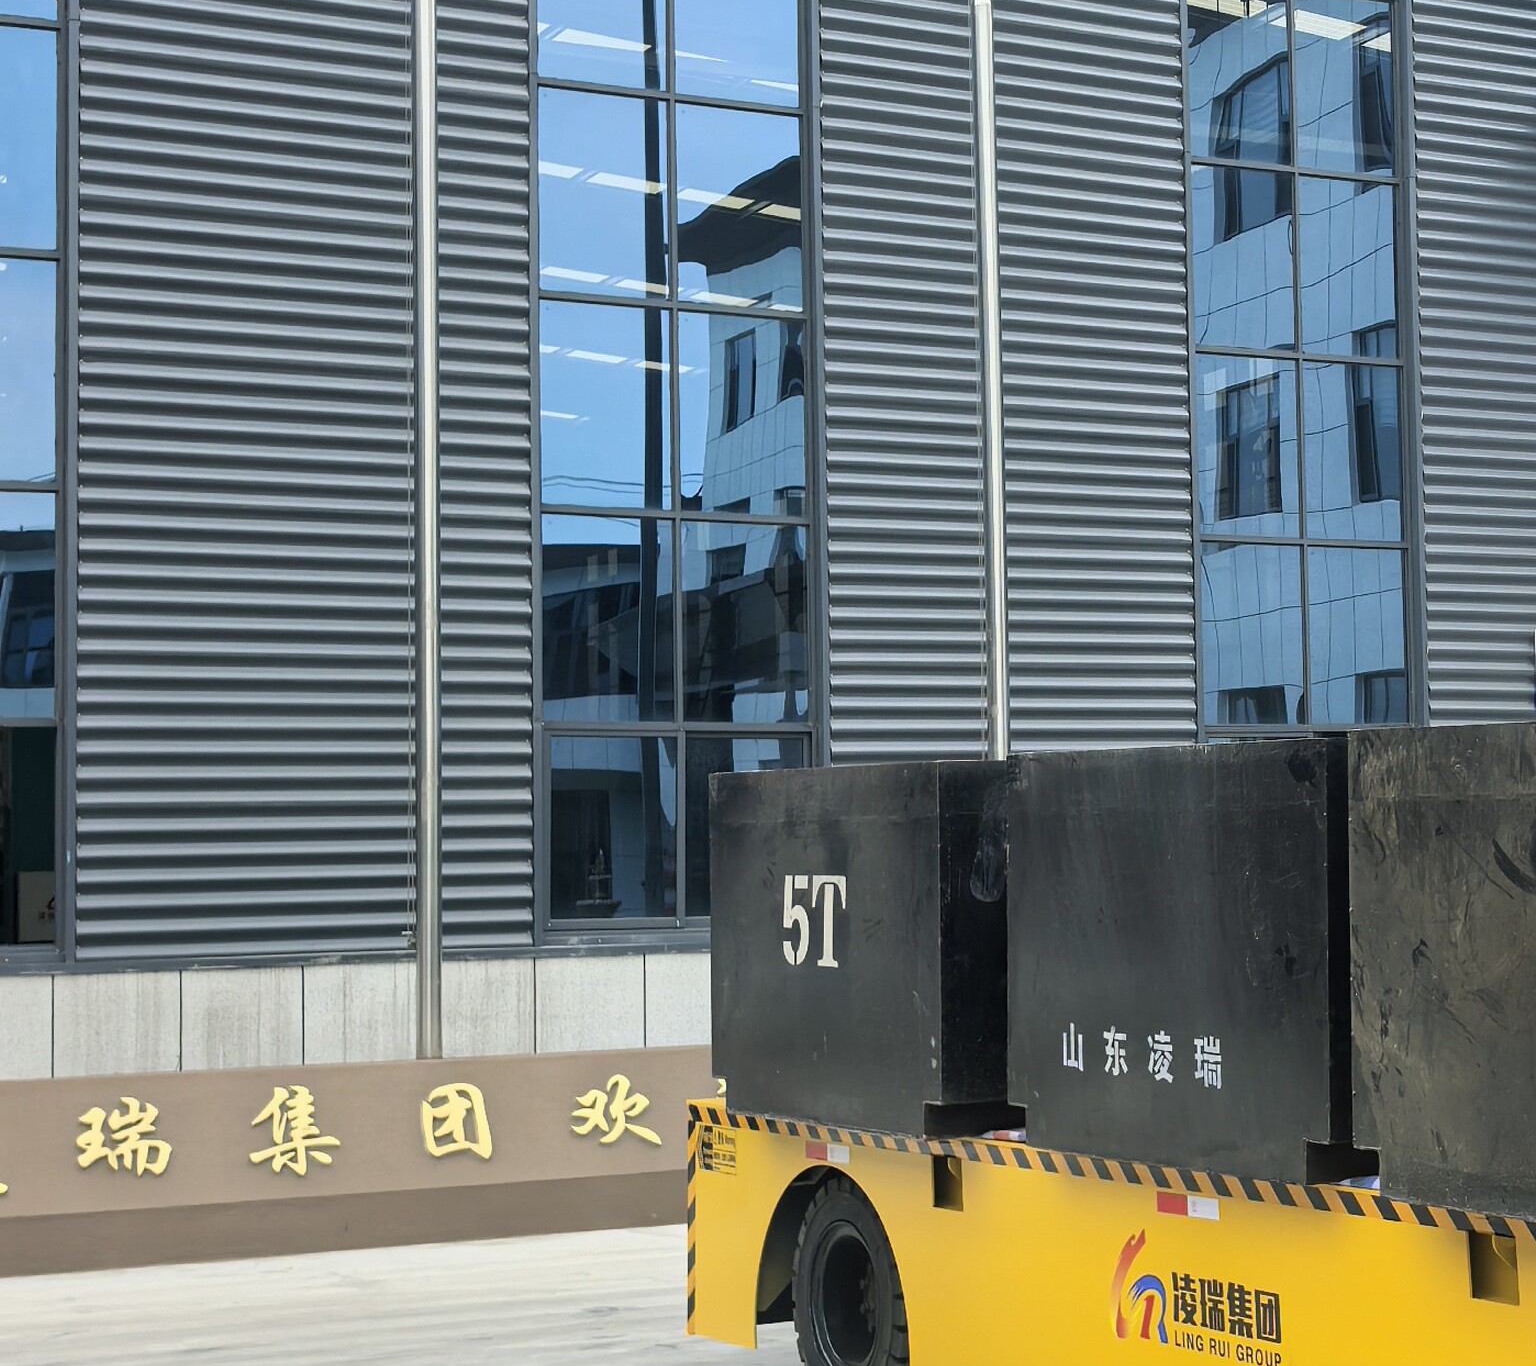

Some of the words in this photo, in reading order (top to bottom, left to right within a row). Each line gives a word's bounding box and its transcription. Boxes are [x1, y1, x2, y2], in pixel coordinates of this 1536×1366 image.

[782, 875, 846, 968] 5T
[1062, 1023, 1223, 1090] 山东凌瑞
[0, 1074, 727, 1195] 瑞集团欢
[1171, 1271, 1282, 1344] 凌瑞集团
[1173, 1330, 1204, 1352] LING
[1209, 1337, 1230, 1359] RUI
